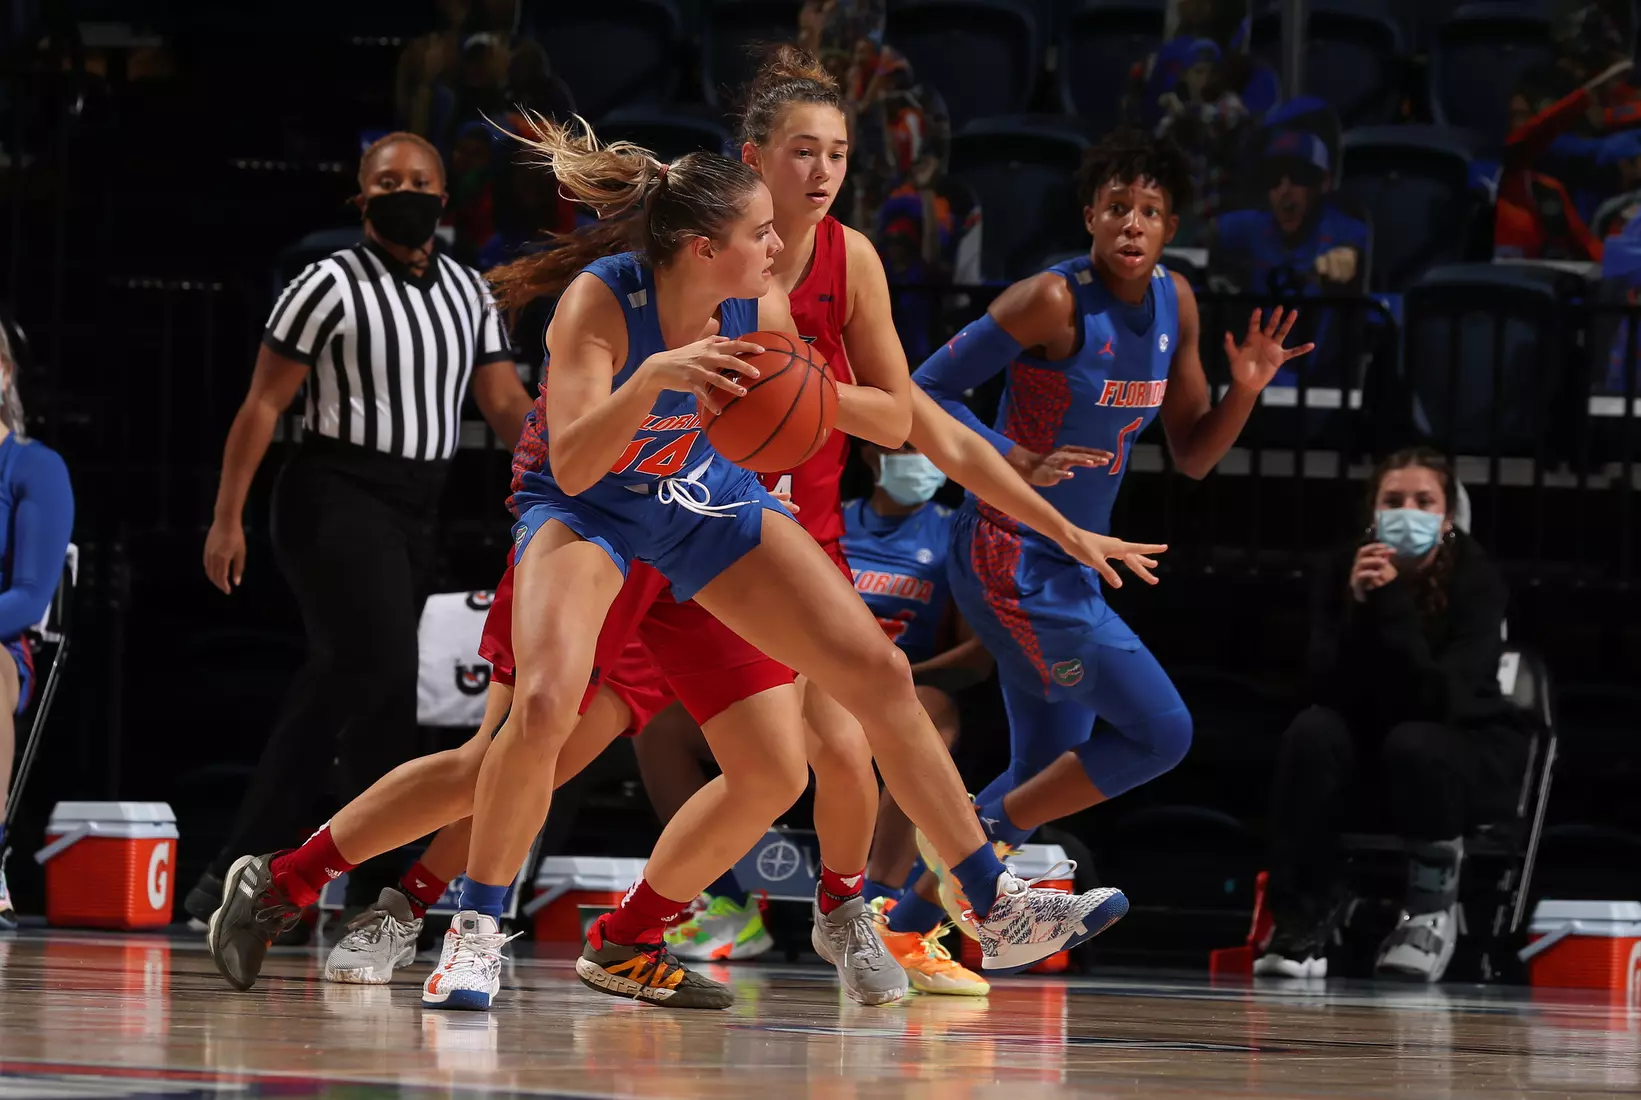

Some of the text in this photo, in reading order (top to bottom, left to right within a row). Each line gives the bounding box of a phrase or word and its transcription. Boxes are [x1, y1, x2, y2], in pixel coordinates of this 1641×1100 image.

[639, 411, 703, 432] LORI
[1108, 416, 1145, 475] 1
[610, 430, 700, 479] 14
[850, 567, 934, 605] LORIDA
[147, 841, 170, 911] G
